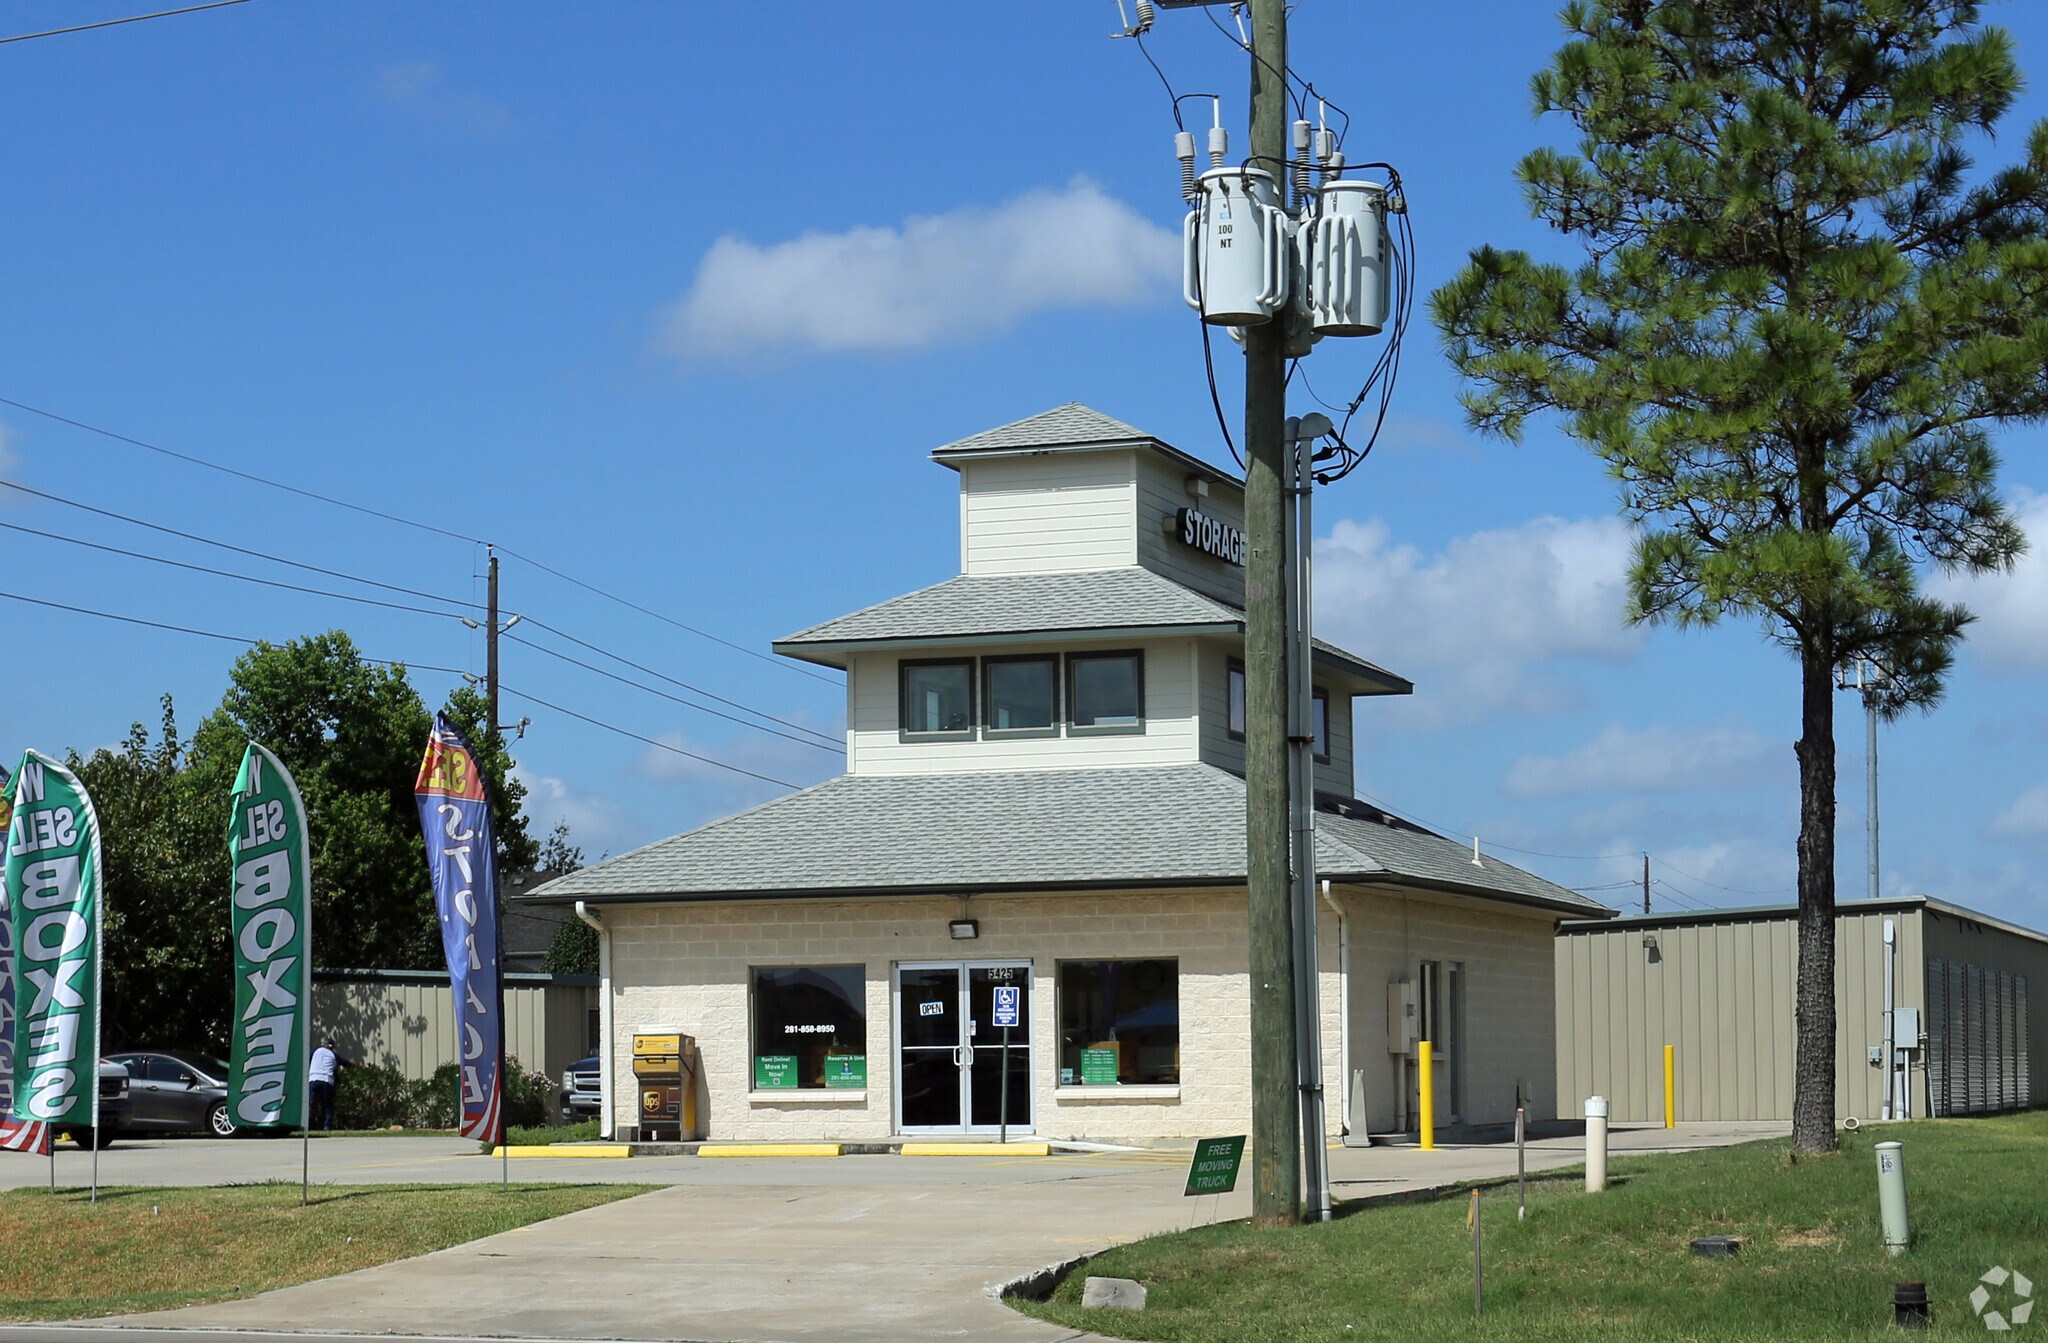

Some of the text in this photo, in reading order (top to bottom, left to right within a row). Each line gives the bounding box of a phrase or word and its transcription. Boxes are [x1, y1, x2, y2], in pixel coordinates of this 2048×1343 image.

[1218, 224, 1233, 235] 100
[1220, 238, 1232, 249] NT
[1185, 508, 1246, 567] STORAGE
[988, 967, 1013, 979] 5425
[921, 1003, 942, 1015] OPEN
[784, 1025, 835, 1033] 281-858-8950
[645, 1097, 659, 1109] ups
[1207, 1143, 1232, 1157] FREE
[1197, 1159, 1234, 1173] MOVING
[1197, 1175, 1228, 1188] TRUCK
